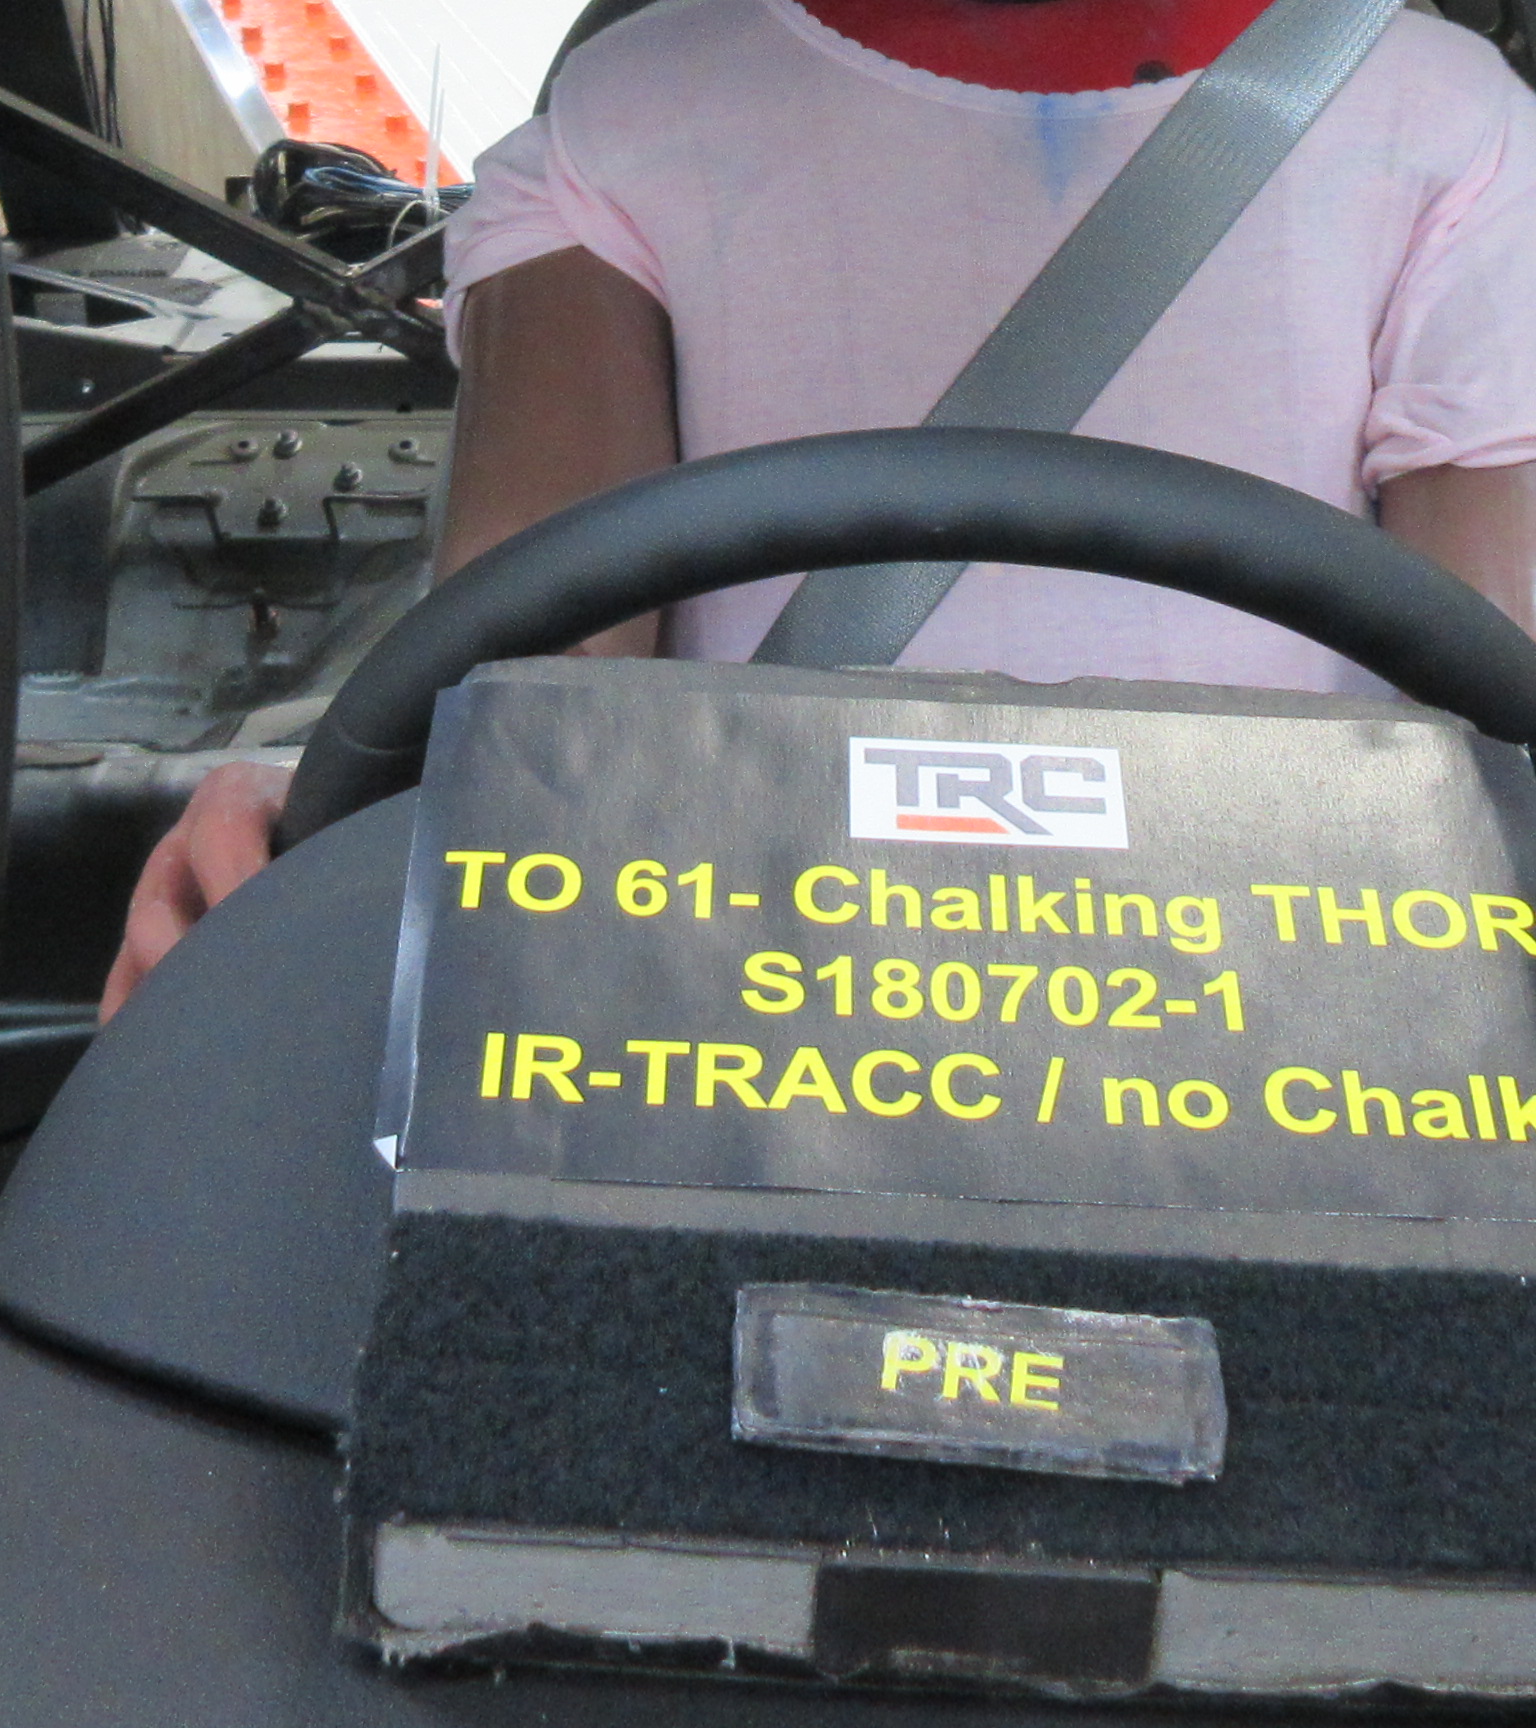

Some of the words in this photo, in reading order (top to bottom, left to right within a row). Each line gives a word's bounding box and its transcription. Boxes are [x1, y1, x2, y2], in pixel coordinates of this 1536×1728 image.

[864, 747, 1106, 836] TRC
[443, 849, 584, 916] TO
[614, 858, 763, 921] 61-
[791, 865, 1224, 954] Chalking
[740, 951, 1247, 1032] S180702-1
[479, 1031, 1004, 1120] IR-TRACC
[1037, 1056, 1066, 1124] /
[1102, 1077, 1232, 1131] no
[878, 1330, 1065, 1411] PRE
